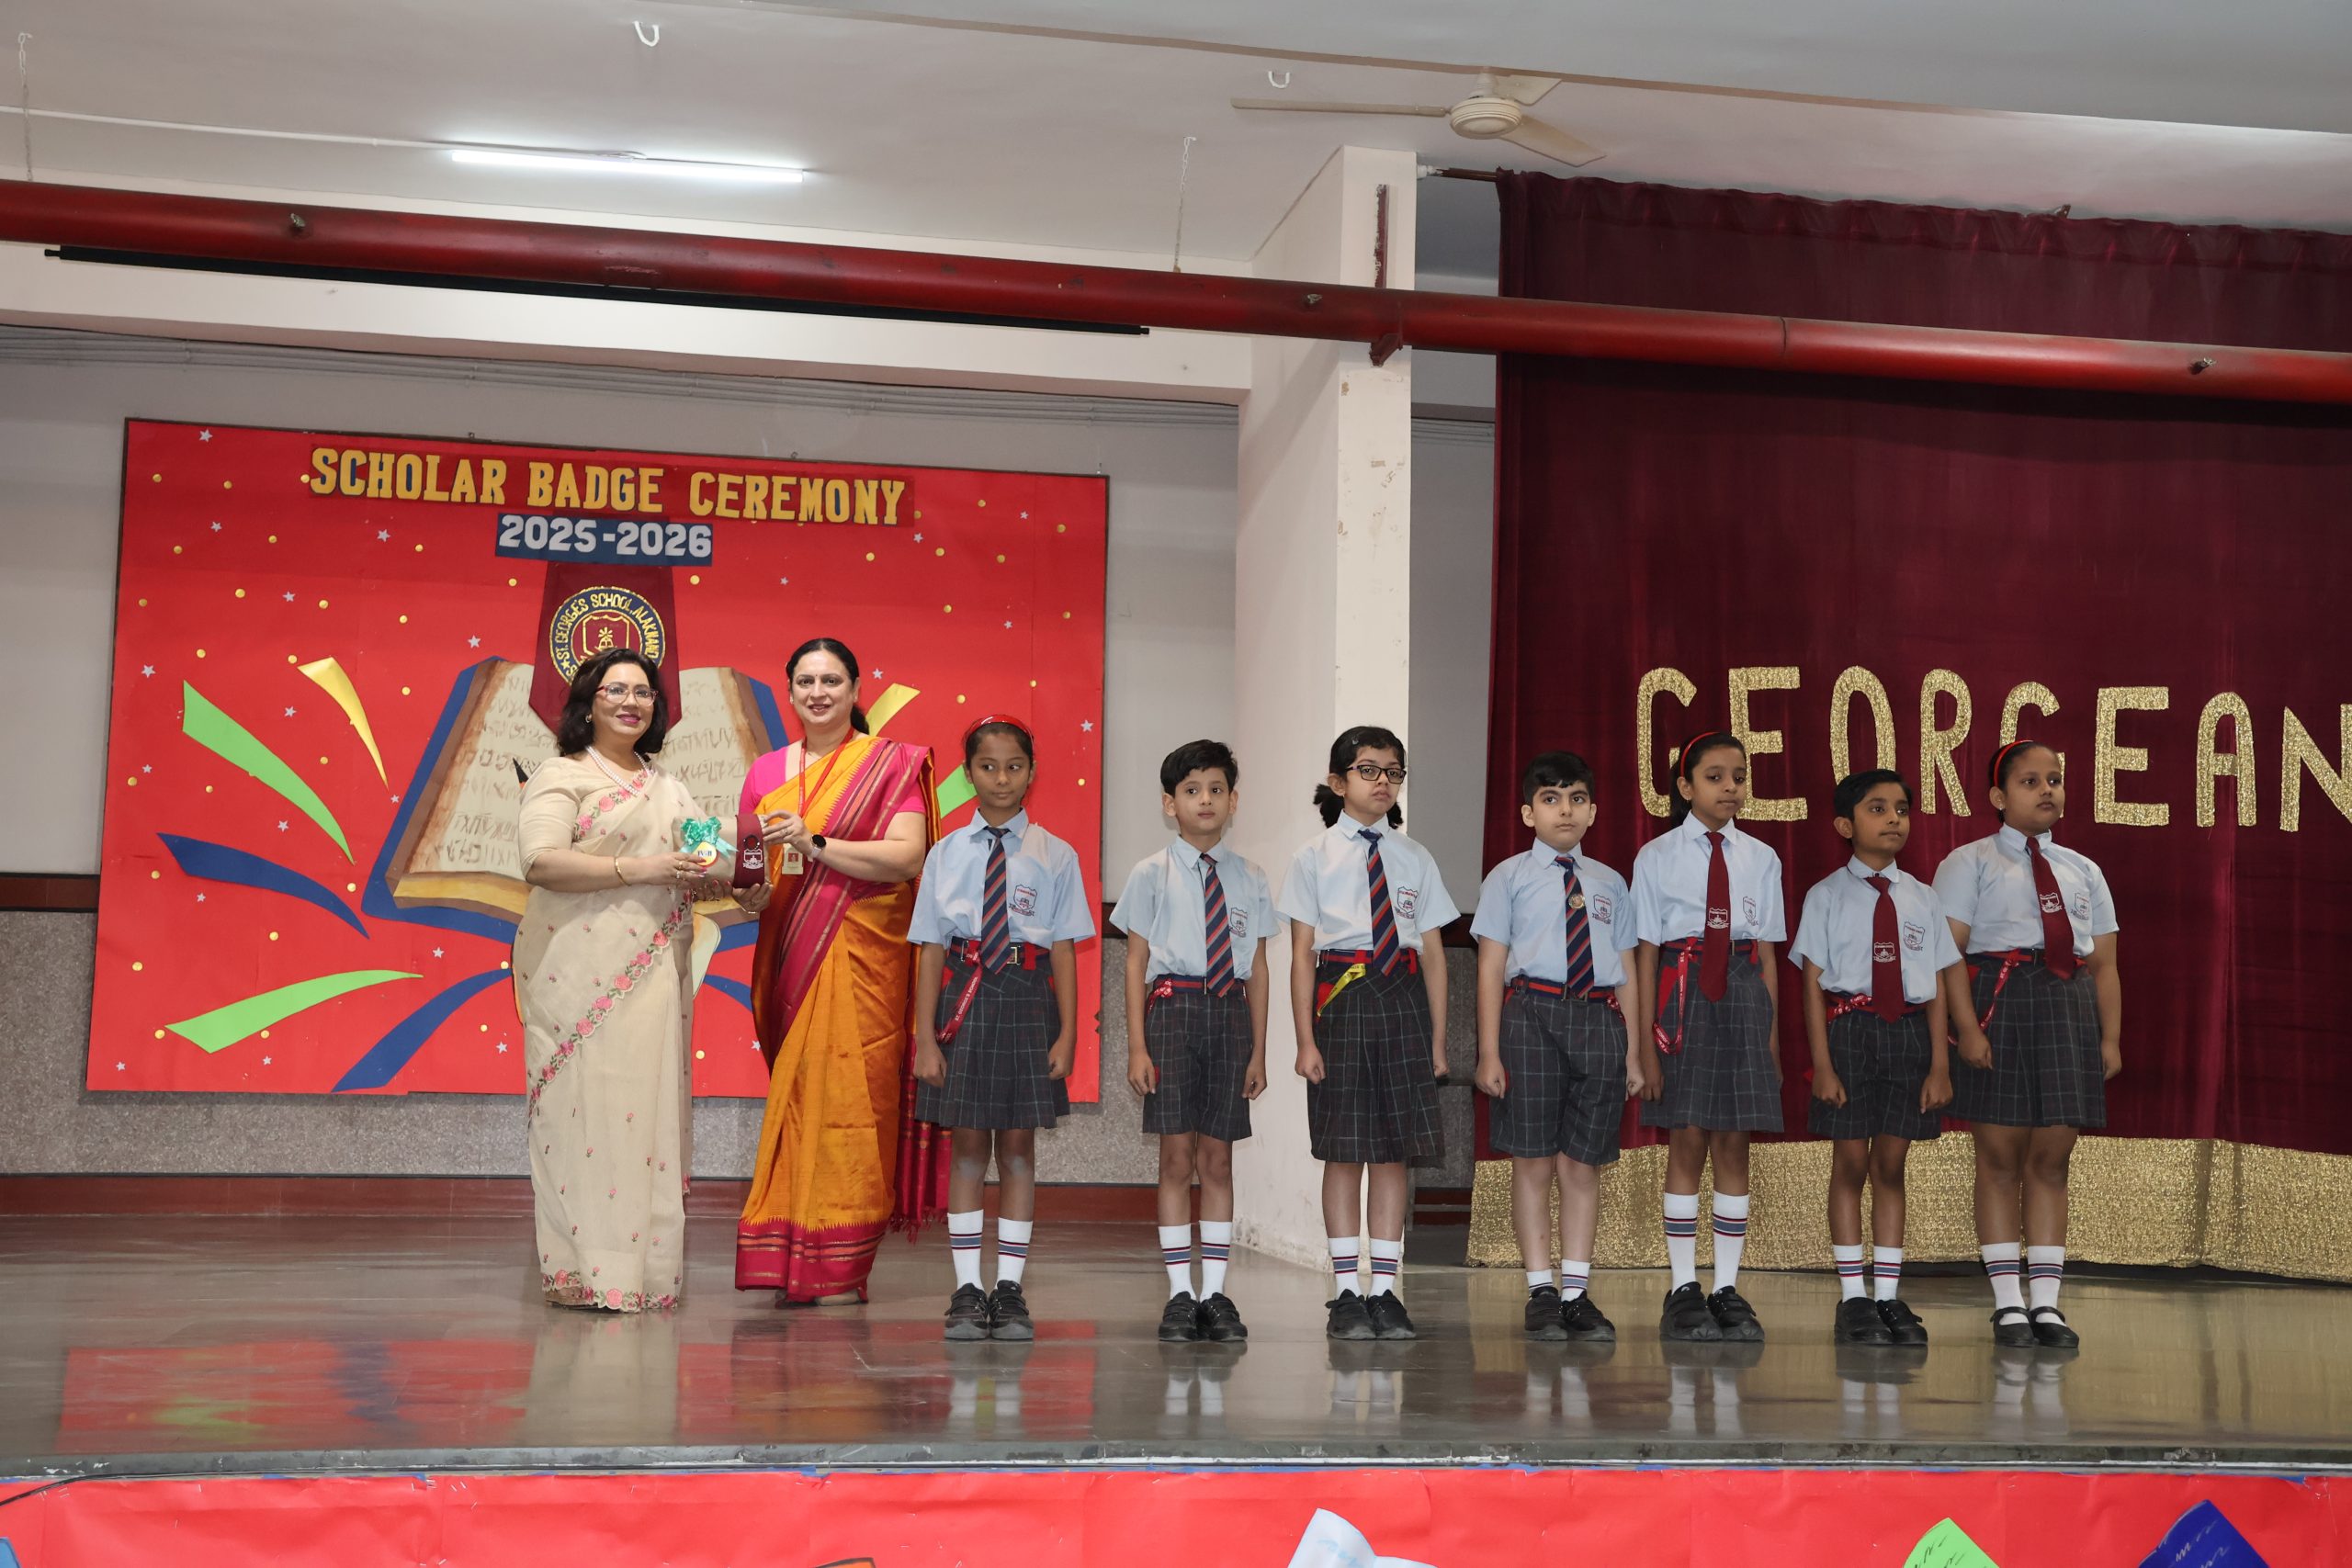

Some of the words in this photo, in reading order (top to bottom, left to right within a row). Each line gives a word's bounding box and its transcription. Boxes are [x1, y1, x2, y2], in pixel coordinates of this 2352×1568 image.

[310, 447, 507, 505] SCHOLAR
[526, 461, 664, 513] BADGE
[688, 470, 906, 525] CEREMONY
[498, 513, 713, 558] 2025-2026
[555, 599, 589, 643] GEORGE'S
[631, 605, 660, 663] ALAKNAND
